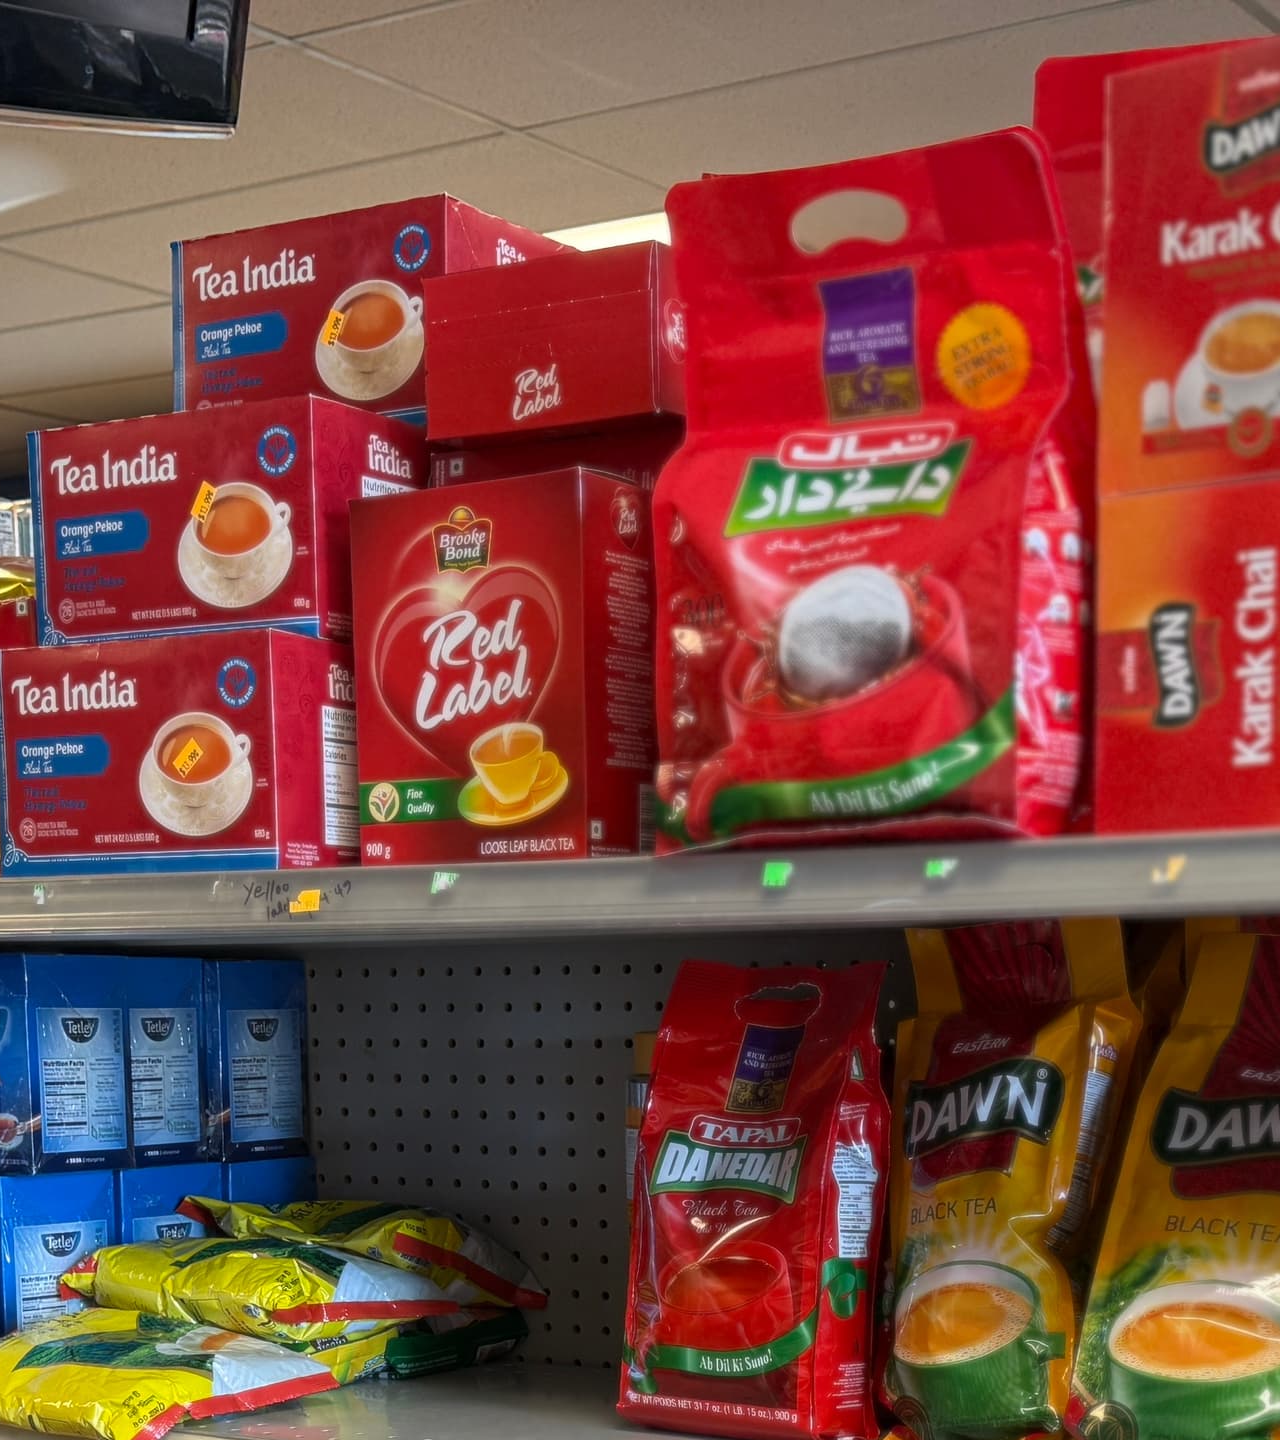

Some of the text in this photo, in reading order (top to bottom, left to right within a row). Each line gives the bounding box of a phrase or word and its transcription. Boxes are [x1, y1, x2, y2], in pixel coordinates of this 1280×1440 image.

[1161, 207, 1264, 267] Karak
[192, 247, 316, 302] Tea India
[200, 320, 263, 342] Orange Pekoe
[515, 363, 558, 396] Red
[512, 383, 561, 421] Label
[368, 434, 390, 454] Tea
[51, 444, 178, 496] Tea India
[368, 445, 413, 480] India
[61, 518, 124, 539] Orange Pekoe
[438, 530, 488, 549] Brooke
[443, 543, 482, 562] Bond
[422, 598, 524, 671] Red
[1160, 609, 1193, 719] DAWN
[1232, 546, 1278, 769] Karak Chai
[11, 669, 138, 716] Tea India
[414, 644, 532, 731] Label
[21, 742, 84, 759] Orange Pekoe
[406, 787, 424, 801] Fine
[808, 783, 836, 814] Ab
[837, 782, 869, 814] Dil
[406, 801, 436, 816] Quality
[366, 842, 382, 856] 900
[480, 837, 575, 855] LOOSE LEAF BLACK TEA
[65, 1019, 95, 1037] Tetley
[144, 1019, 171, 1036] Tetley
[250, 1020, 275, 1036] Tetley
[951, 1036, 1012, 1056] EASTERN
[911, 1072, 1044, 1143] DAWN
[698, 1121, 793, 1144] TAPAL
[655, 1141, 798, 1193] DANEDAR
[681, 1199, 761, 1217] Black Tea
[909, 1196, 999, 1226] BLACK TEA
[1164, 1214, 1240, 1242] BLACK
[45, 1235, 77, 1251] Tetley
[699, 1348, 773, 1374] Ab Dil Ki Suno!
[677, 1399, 692, 1410] NET
[693, 1401, 710, 1412] 31.7
[773, 1410, 790, 1422] 900
